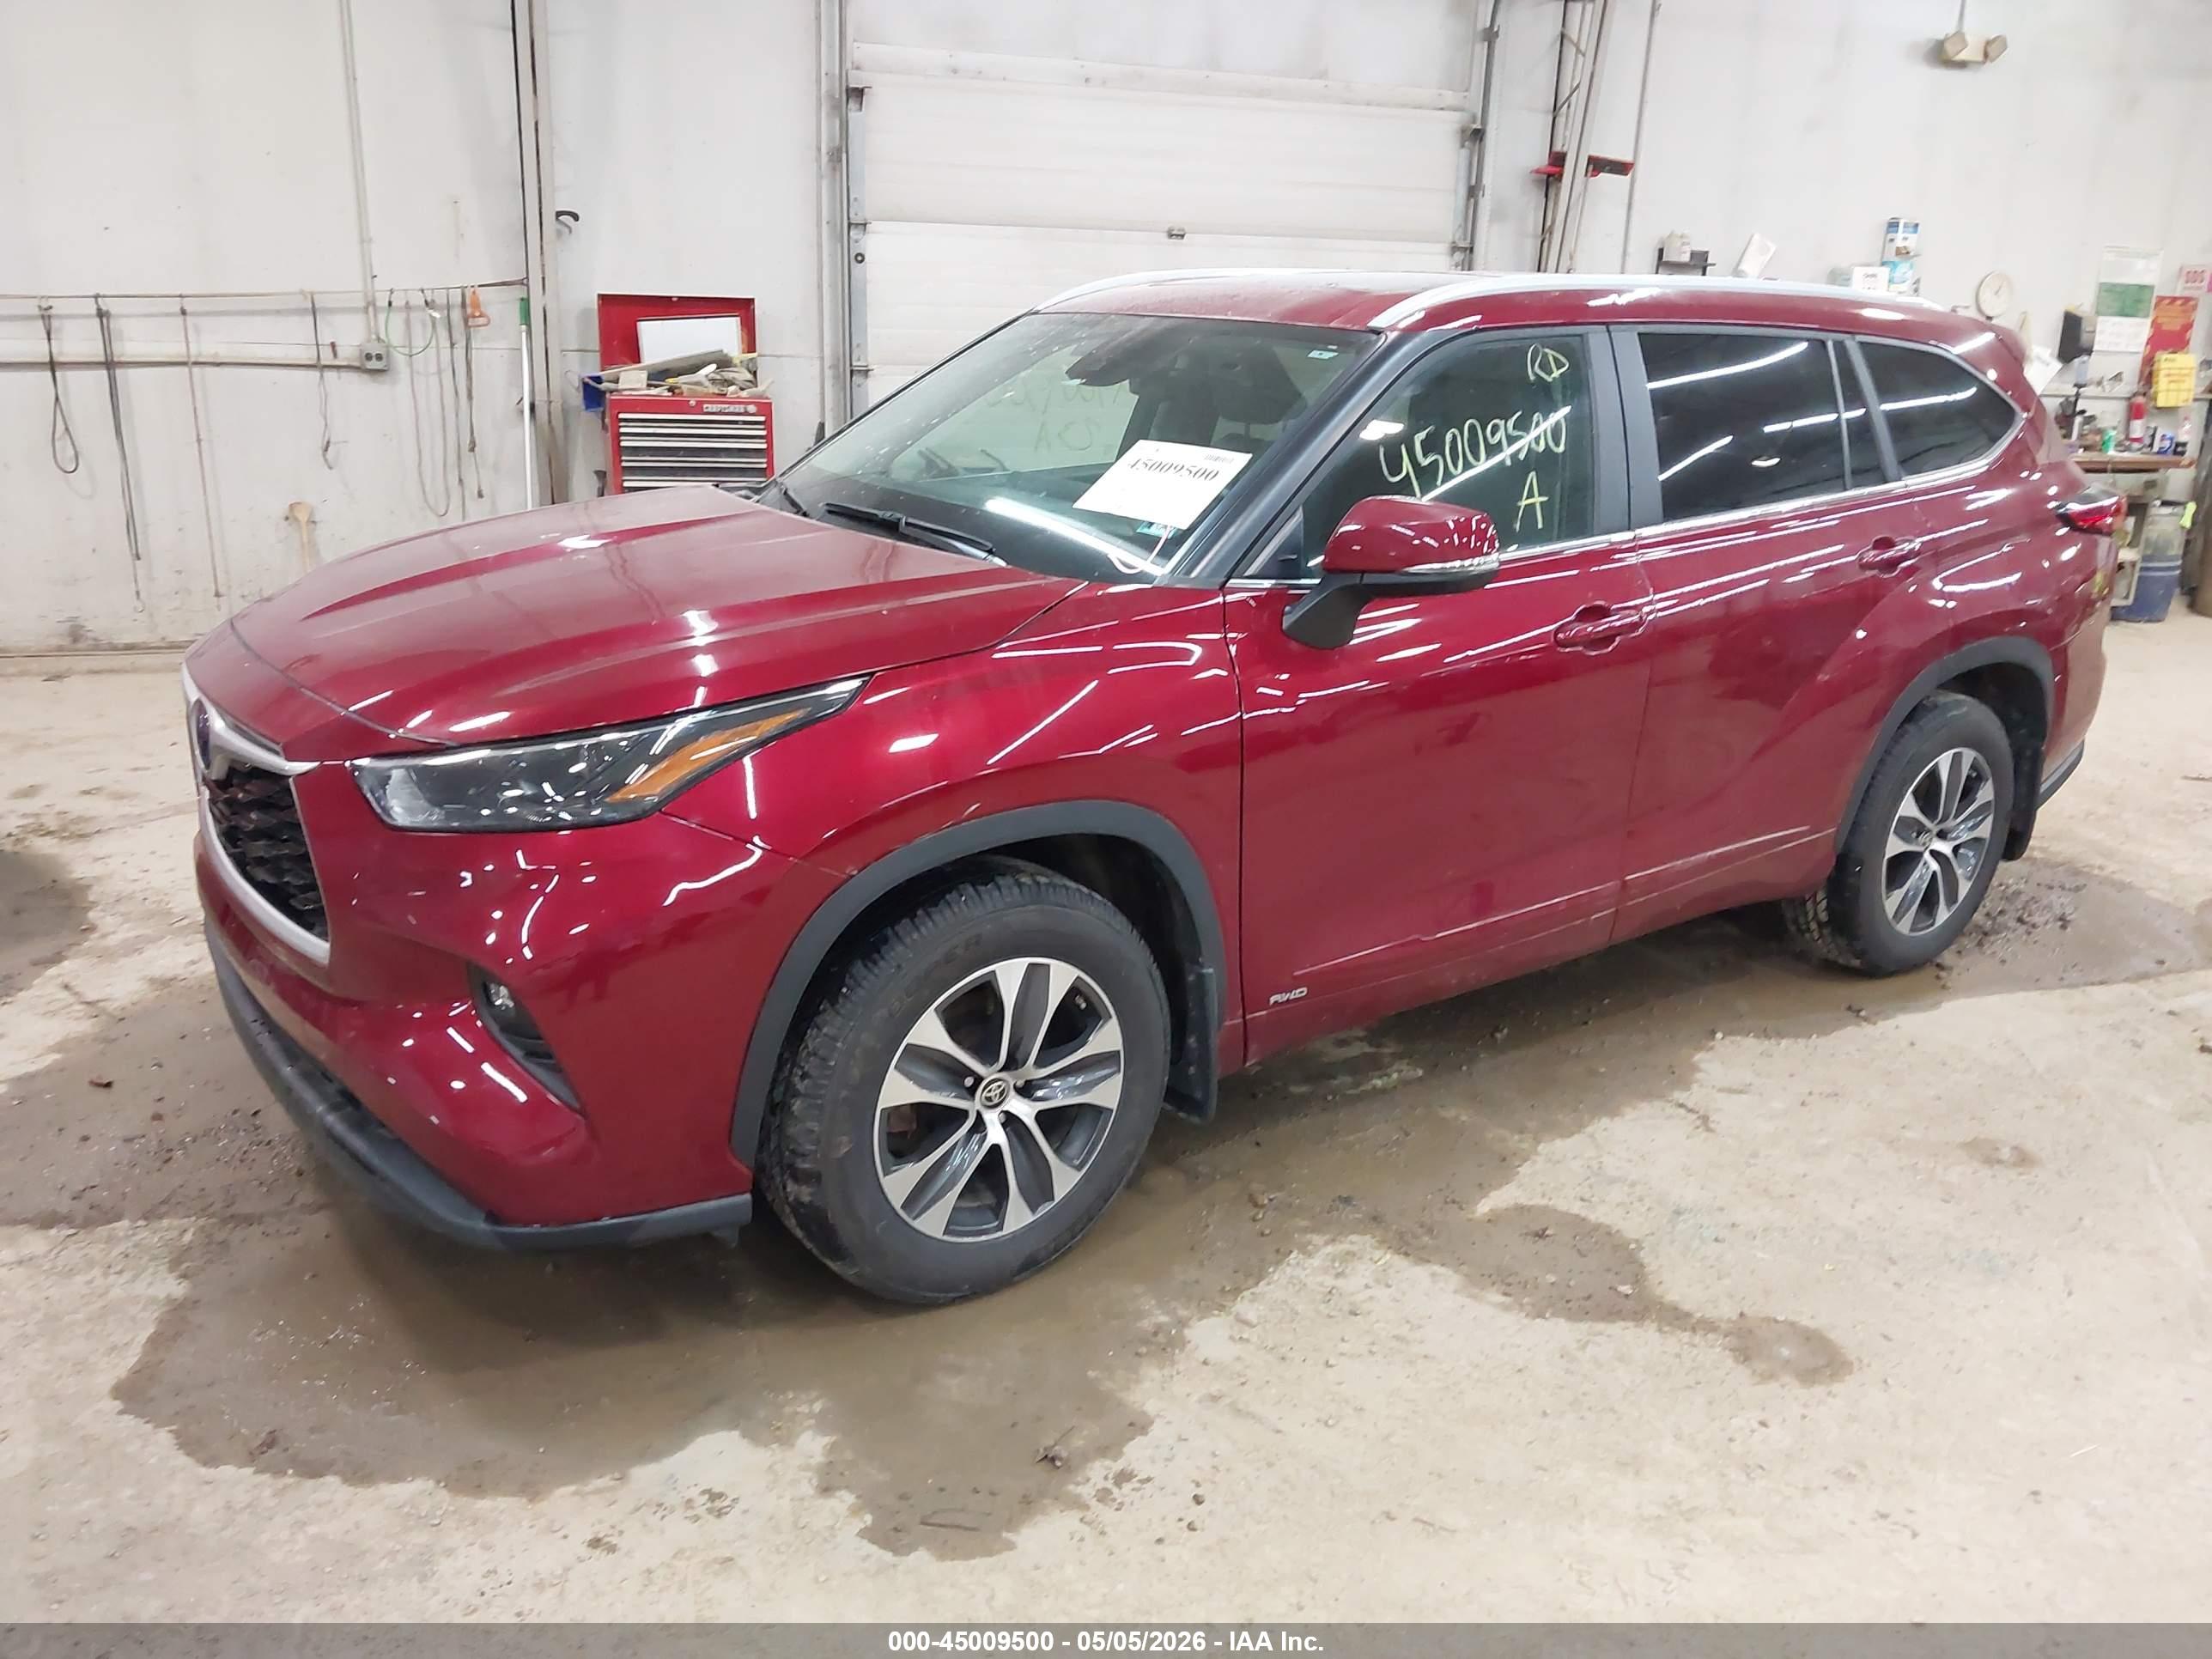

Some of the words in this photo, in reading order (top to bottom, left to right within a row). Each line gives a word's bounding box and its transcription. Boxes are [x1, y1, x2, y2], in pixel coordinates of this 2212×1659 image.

[1528, 343, 1569, 382] RD
[1127, 457, 1220, 482] 45009500
[1379, 409, 1567, 500] 45009500
[1516, 471, 1549, 532] A
[1268, 987, 1308, 1006] AWD
